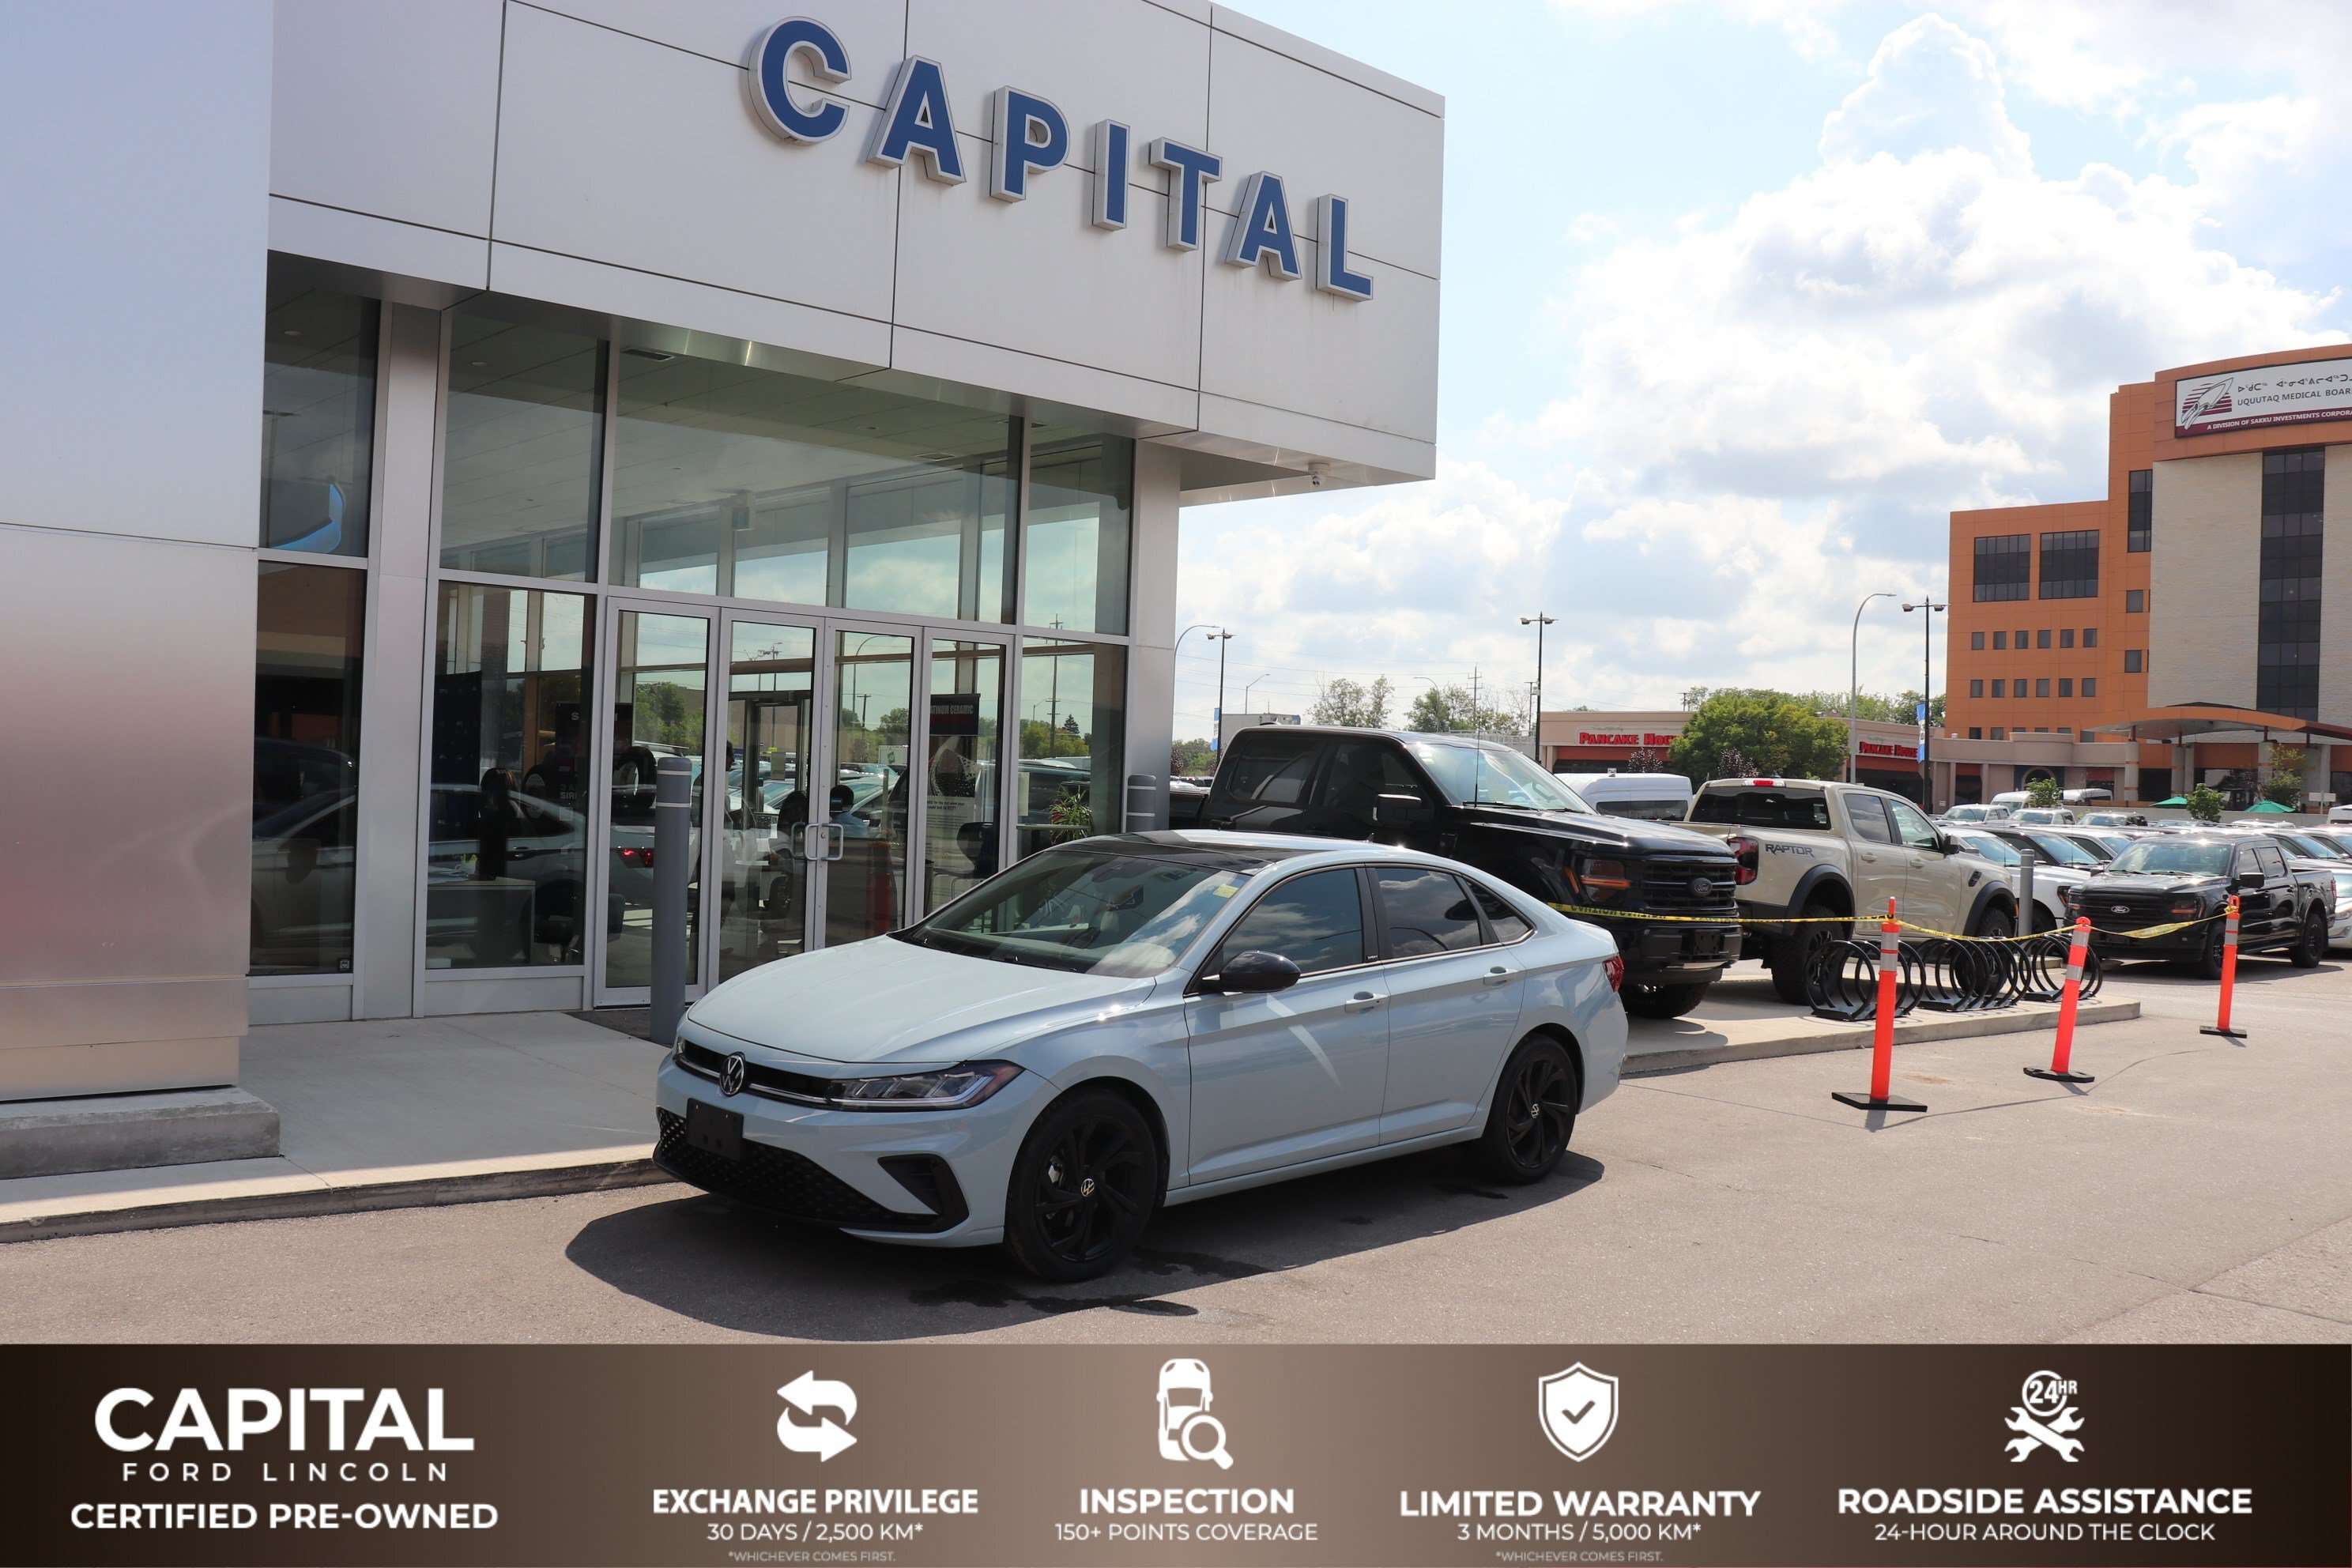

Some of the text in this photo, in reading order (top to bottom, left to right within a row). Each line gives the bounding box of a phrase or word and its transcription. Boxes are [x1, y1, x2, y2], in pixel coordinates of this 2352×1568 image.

[748, 17, 1374, 302] CAPITAL
[2237, 394, 2280, 406] UQUUTAQ
[2282, 390, 2321, 401] MEDICAL
[2213, 420, 2240, 429] DIVISION
[2273, 412, 2320, 422] INVESTMENTS
[1579, 732, 1639, 744] PANCAKE
[1765, 844, 1815, 858] RAPTOR
